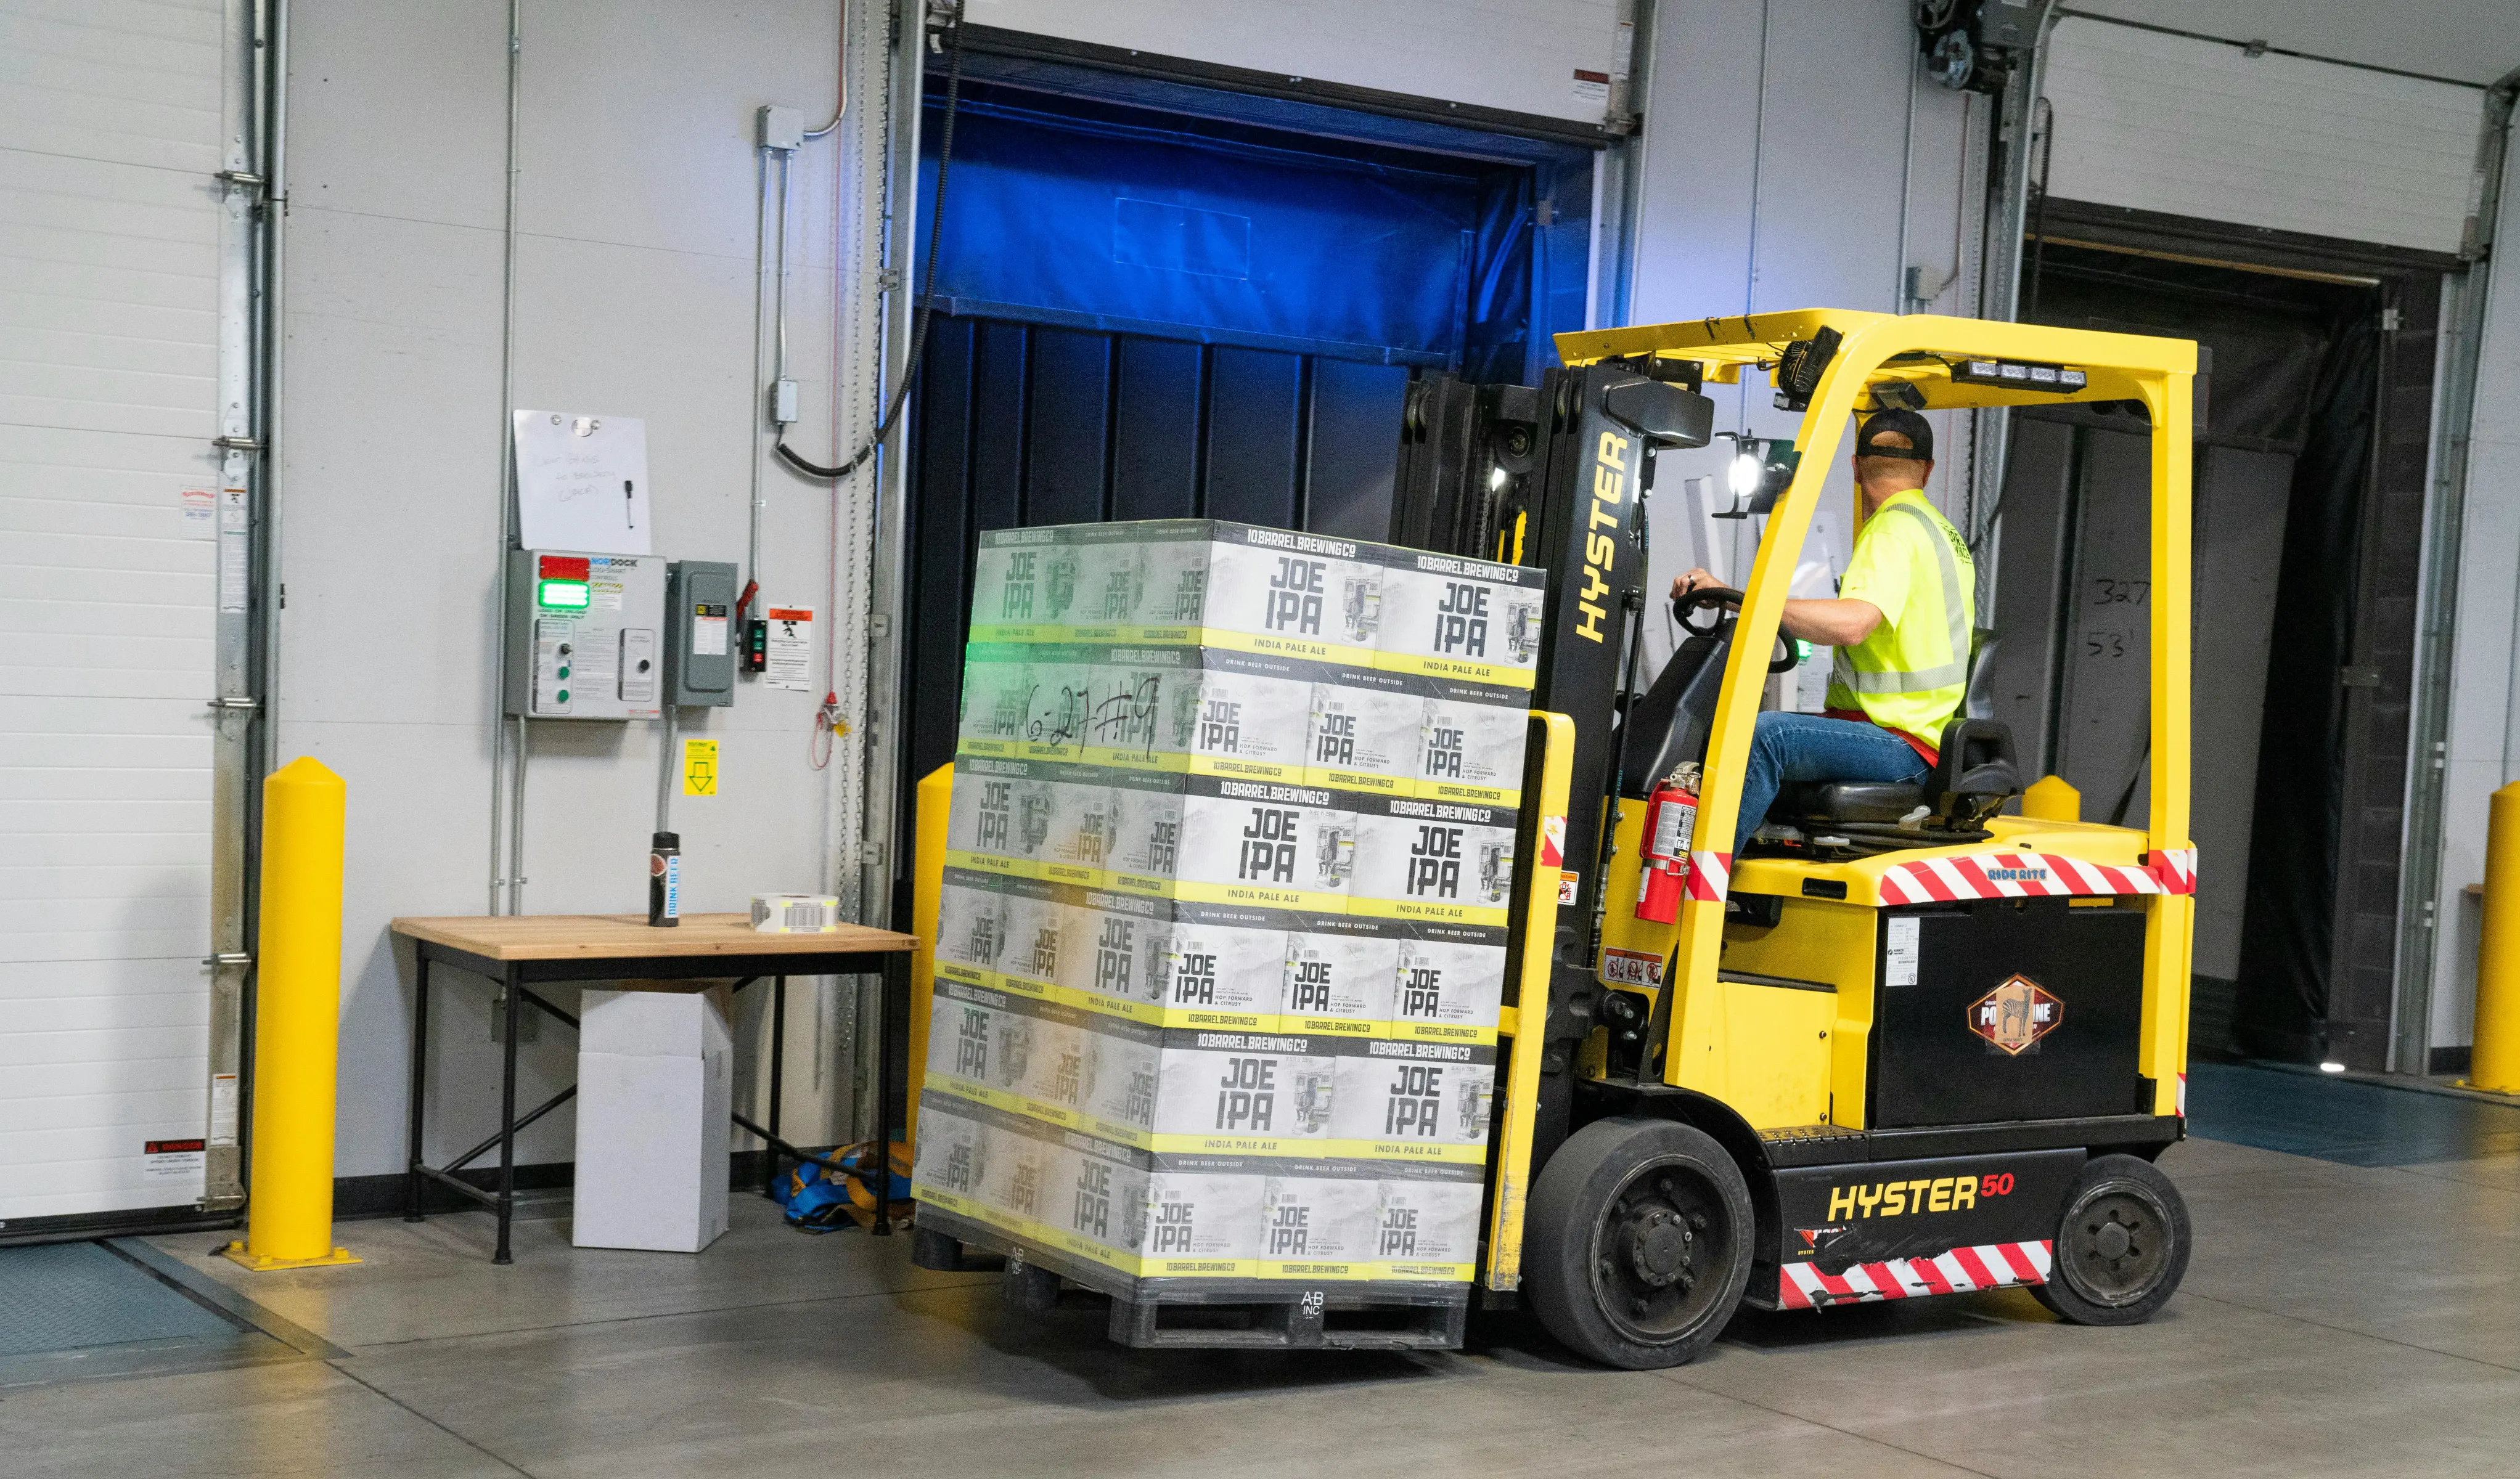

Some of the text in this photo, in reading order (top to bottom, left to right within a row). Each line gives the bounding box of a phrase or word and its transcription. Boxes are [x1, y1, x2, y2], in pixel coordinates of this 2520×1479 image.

[1576, 431, 1627, 643] HYSTER
[1005, 552, 1037, 581] JOE
[1270, 556, 1326, 594] JOE
[1177, 571, 1203, 592] JOE
[2095, 579, 2151, 605] 327
[1002, 583, 1034, 619] IPA
[1174, 595, 1201, 621] IPA
[1265, 590, 1323, 635] IPA
[1439, 582, 1491, 617] JOE
[1254, 639, 1326, 655] INDIA PALE ALE
[1434, 614, 1487, 657] IPA
[1265, 664, 1290, 672] OUTSIDE
[1343, 672, 1360, 680] DRINK
[1424, 661, 1490, 677] INDIA PALE ALE
[1125, 672, 1162, 703] JOE
[1120, 704, 1159, 745] IPA
[1203, 700, 1241, 725] JOE
[1319, 713, 1356, 737] JOE
[1200, 722, 1239, 753] IPA
[1316, 735, 1354, 765] IPA
[1429, 727, 1463, 751] JOE
[1426, 749, 1462, 778] IPA
[980, 781, 1010, 811] JOE
[976, 811, 1008, 850] IPA
[1150, 821, 1176, 845] JOE
[1244, 807, 1299, 842] JOE
[1412, 826, 1463, 858] JOE
[970, 856, 1009, 868] INDIA PALE ALE
[1147, 845, 1174, 874] IPA
[1239, 840, 1296, 883] IPA
[1407, 857, 1460, 898] IPA
[1988, 870, 2045, 880] RIDE RITE
[1228, 889, 1254, 898] INDIA
[1259, 892, 1280, 901] PALE
[1397, 905, 1422, 913] INDIA
[1425, 907, 1445, 916] PALE
[972, 916, 993, 939] JOE
[1034, 928, 1058, 951] JOE
[1098, 917, 1134, 952] JOE
[970, 937, 992, 965] IPA
[1032, 949, 1057, 978] IPA
[1178, 953, 1217, 976] JOE
[1095, 949, 1131, 993] IPA
[1295, 961, 1332, 984] JOE
[1406, 968, 1441, 991] JOE
[1175, 976, 1214, 1004] IPA
[1292, 984, 1329, 1012] IPA
[1403, 990, 1439, 1017] IPA
[1089, 997, 1132, 1013] INDIA PALE ALE
[959, 1007, 989, 1041] JOE
[956, 1038, 988, 1080] IPA
[1128, 1072, 1154, 1097] JOE
[1221, 1057, 1277, 1090] JOE
[1391, 1065, 1442, 1097] JOE
[1125, 1094, 1151, 1125] IPA
[1216, 1091, 1274, 1131] IPA
[1386, 1098, 1439, 1136] IPA
[1205, 1140, 1232, 1149] INDIA
[1237, 1141, 1257, 1149] PALE
[1375, 1145, 1400, 1154] INDIA
[1404, 1146, 1423, 1154] PALE
[1077, 1159, 1112, 1196] JOE
[1827, 1173, 2015, 1221] HYSTER 50
[1074, 1191, 1110, 1239] IPA
[1156, 1203, 1194, 1224] JOE
[1273, 1206, 1309, 1228] JOE
[1383, 1208, 1418, 1229] JOE
[1153, 1226, 1192, 1252] IPA
[1269, 1229, 1307, 1255] IPA
[1380, 1230, 1417, 1256] IPA
[1301, 1292, 1324, 1305] A-B
[1303, 1305, 1320, 1315] INC
